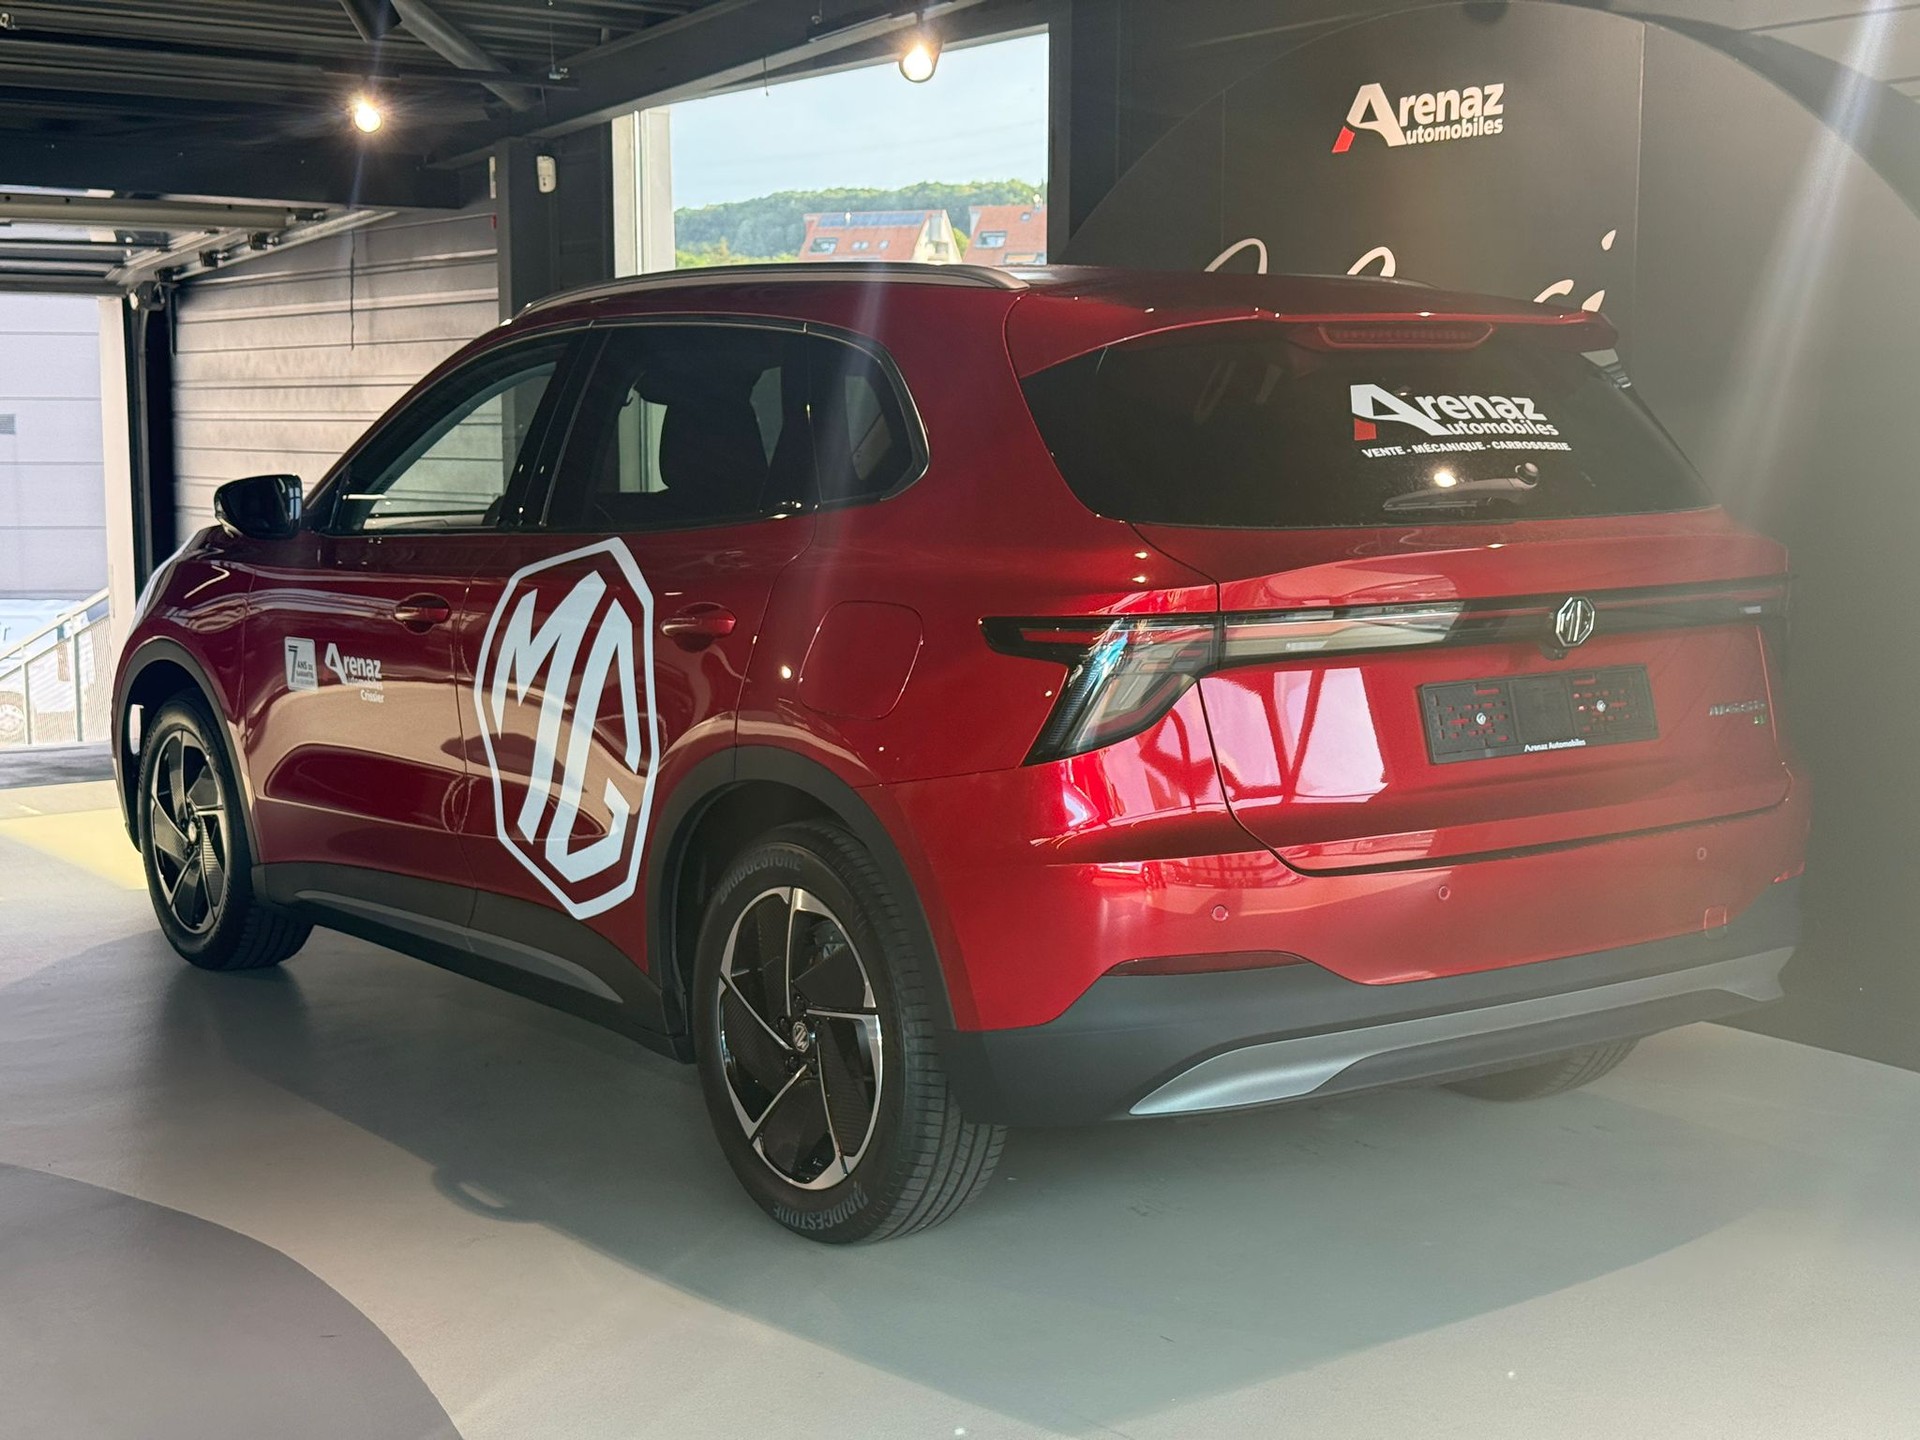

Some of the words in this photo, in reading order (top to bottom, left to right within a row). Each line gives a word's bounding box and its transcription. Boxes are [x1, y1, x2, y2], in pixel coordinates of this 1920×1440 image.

[1332, 83, 1504, 153] Arenaz
[1350, 383, 1547, 440] Arenaz
[1362, 446, 1406, 458] VENTE
[1413, 442, 1486, 455] MÉCANIQUE
[1491, 440, 1572, 452] CARROSSERIE
[1558, 598, 1592, 644] MG
[288, 645, 298, 683] 7
[324, 642, 382, 686] Arenaz
[491, 569, 642, 883] MG
